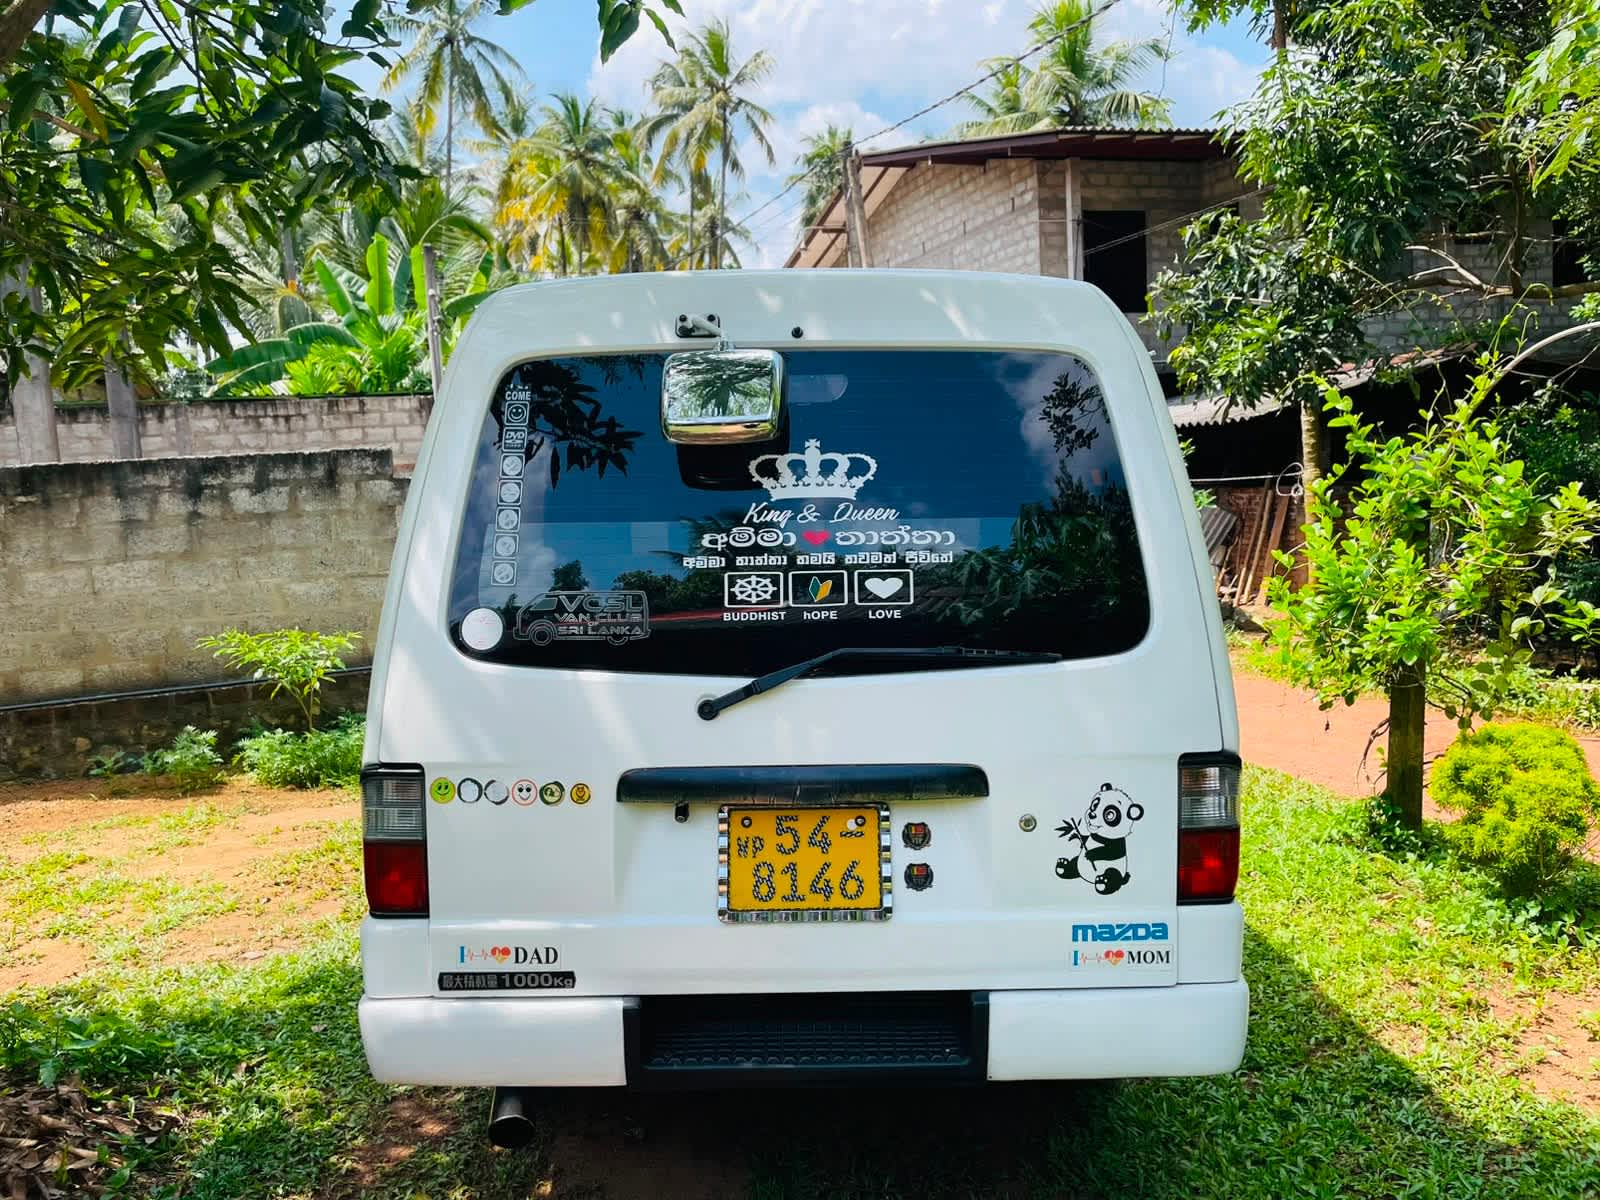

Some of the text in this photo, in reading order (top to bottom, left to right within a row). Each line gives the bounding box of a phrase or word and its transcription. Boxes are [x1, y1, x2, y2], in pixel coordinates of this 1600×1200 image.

[505, 391, 532, 401] COME
[505, 431, 525, 440] DVD
[743, 502, 900, 529] King & Queen
[701, 525, 956, 550] අම්මා තාත්තා
[559, 595, 643, 612] VCSL
[554, 613, 642, 622] VAN CLUB
[722, 611, 787, 622] BUDDHIST
[868, 609, 903, 620] LOVE
[558, 626, 642, 635] SRI LANKA
[736, 836, 765, 858] WP
[752, 860, 865, 903] 8146
[513, 946, 559, 964] DAD
[1127, 950, 1171, 965] MOM
